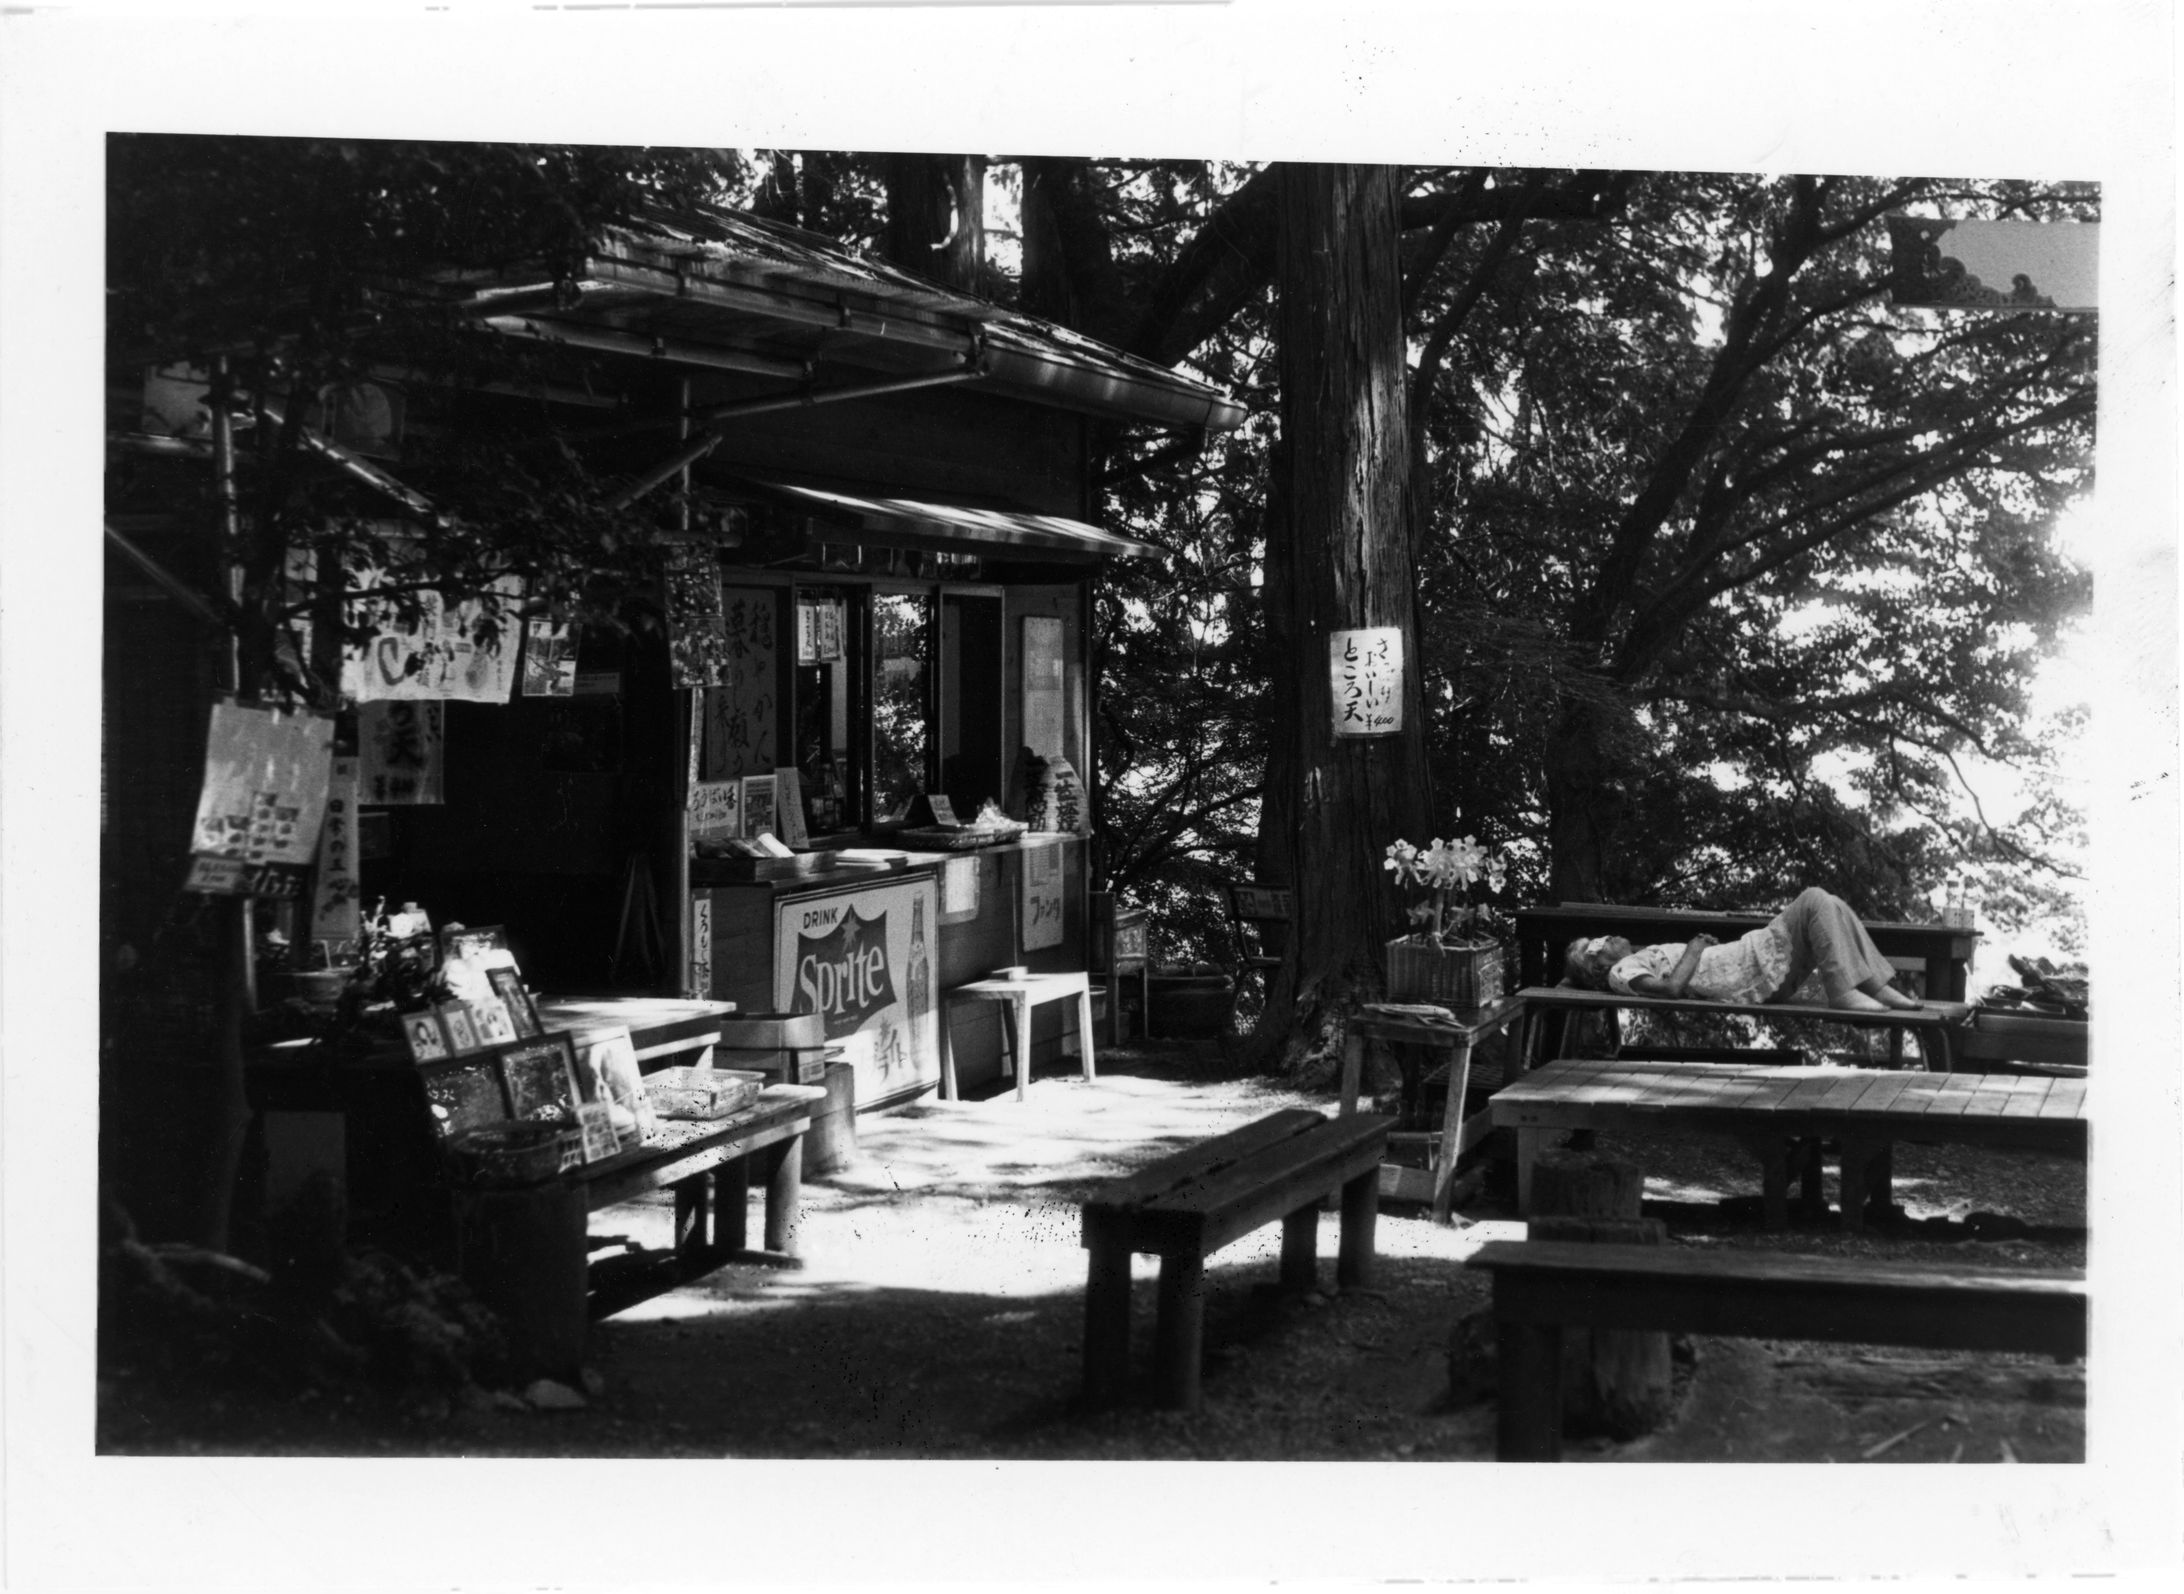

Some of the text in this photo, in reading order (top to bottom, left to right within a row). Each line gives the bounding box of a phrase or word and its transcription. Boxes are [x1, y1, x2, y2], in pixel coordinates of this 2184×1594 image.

[1344, 637, 1364, 722] ところ天
[803, 908, 838, 929] DRINK
[800, 941, 885, 1015] Sprite
